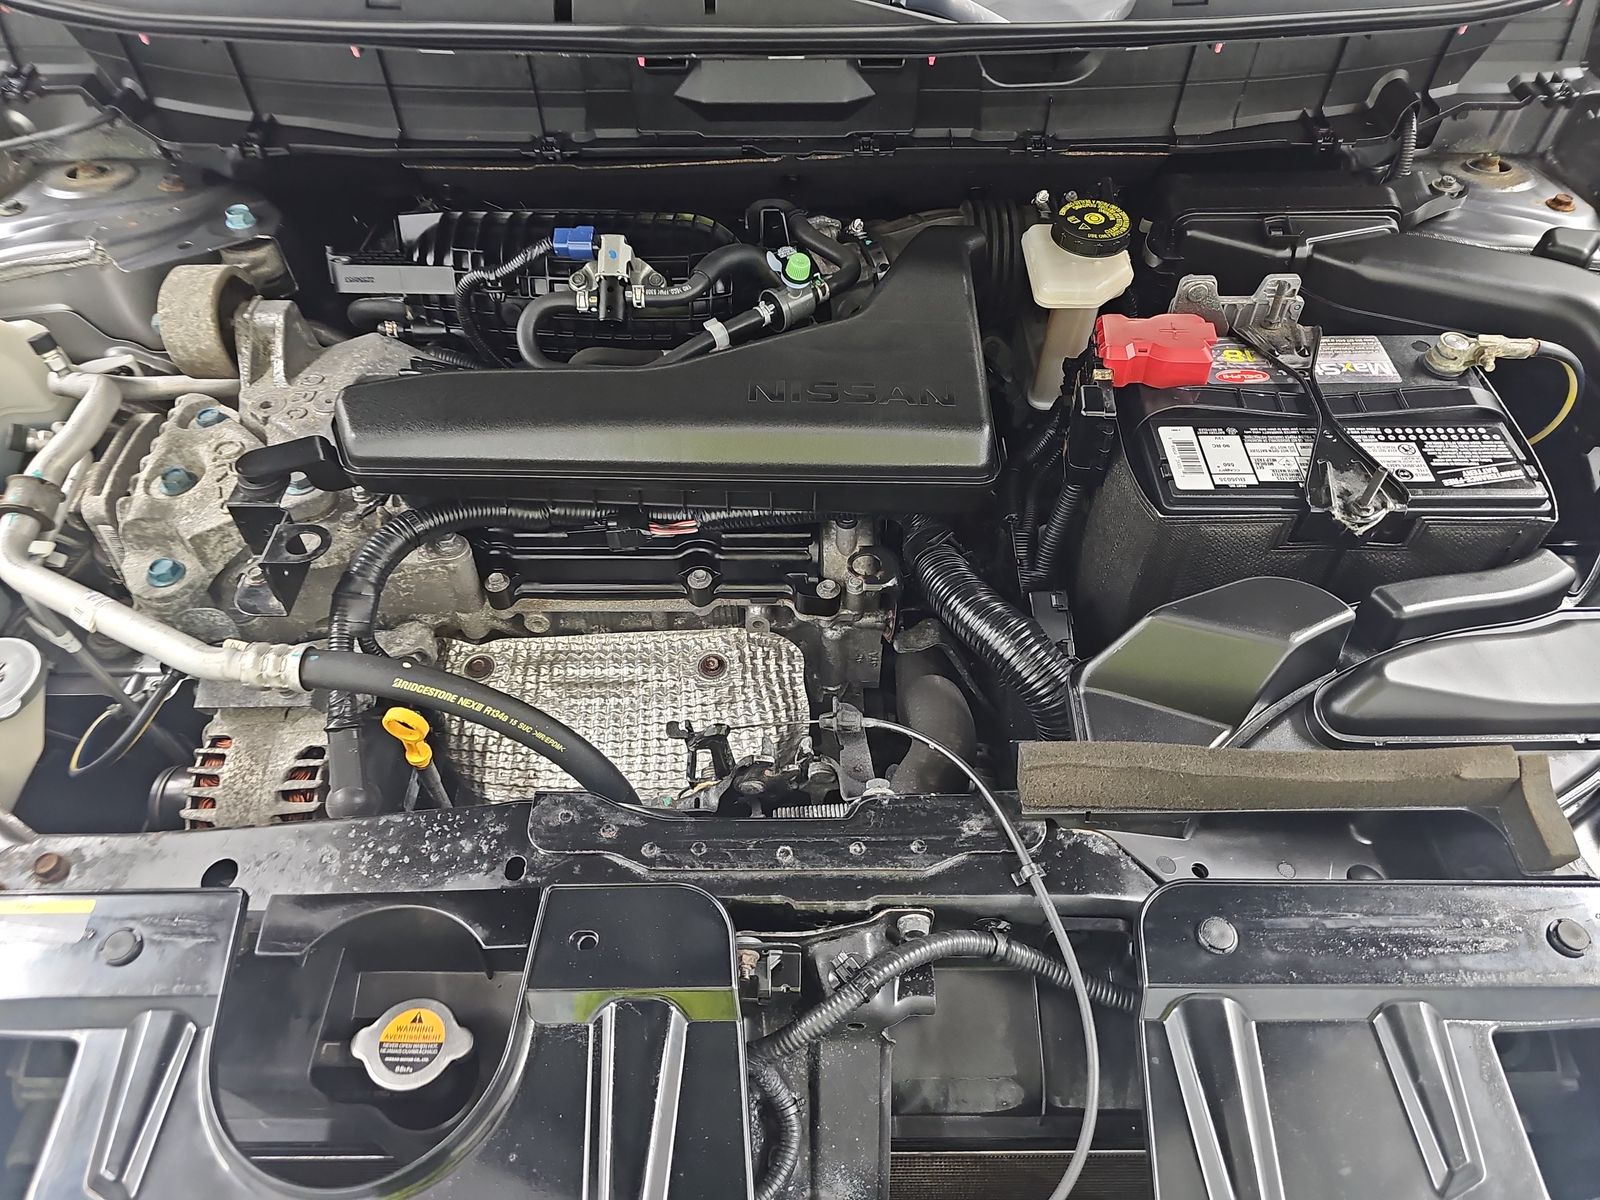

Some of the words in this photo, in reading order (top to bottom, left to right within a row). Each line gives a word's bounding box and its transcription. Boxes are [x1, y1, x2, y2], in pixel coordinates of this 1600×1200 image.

[748, 380, 957, 406] NISSAN
[1442, 470, 1524, 486] MAINTENANCE-FREE
[1462, 467, 1498, 477] BATTERY
[392, 678, 458, 702] BRIDGESTONE
[484, 707, 509, 722] R134a
[509, 718, 517, 726] 15
[517, 722, 533, 733] SUC
